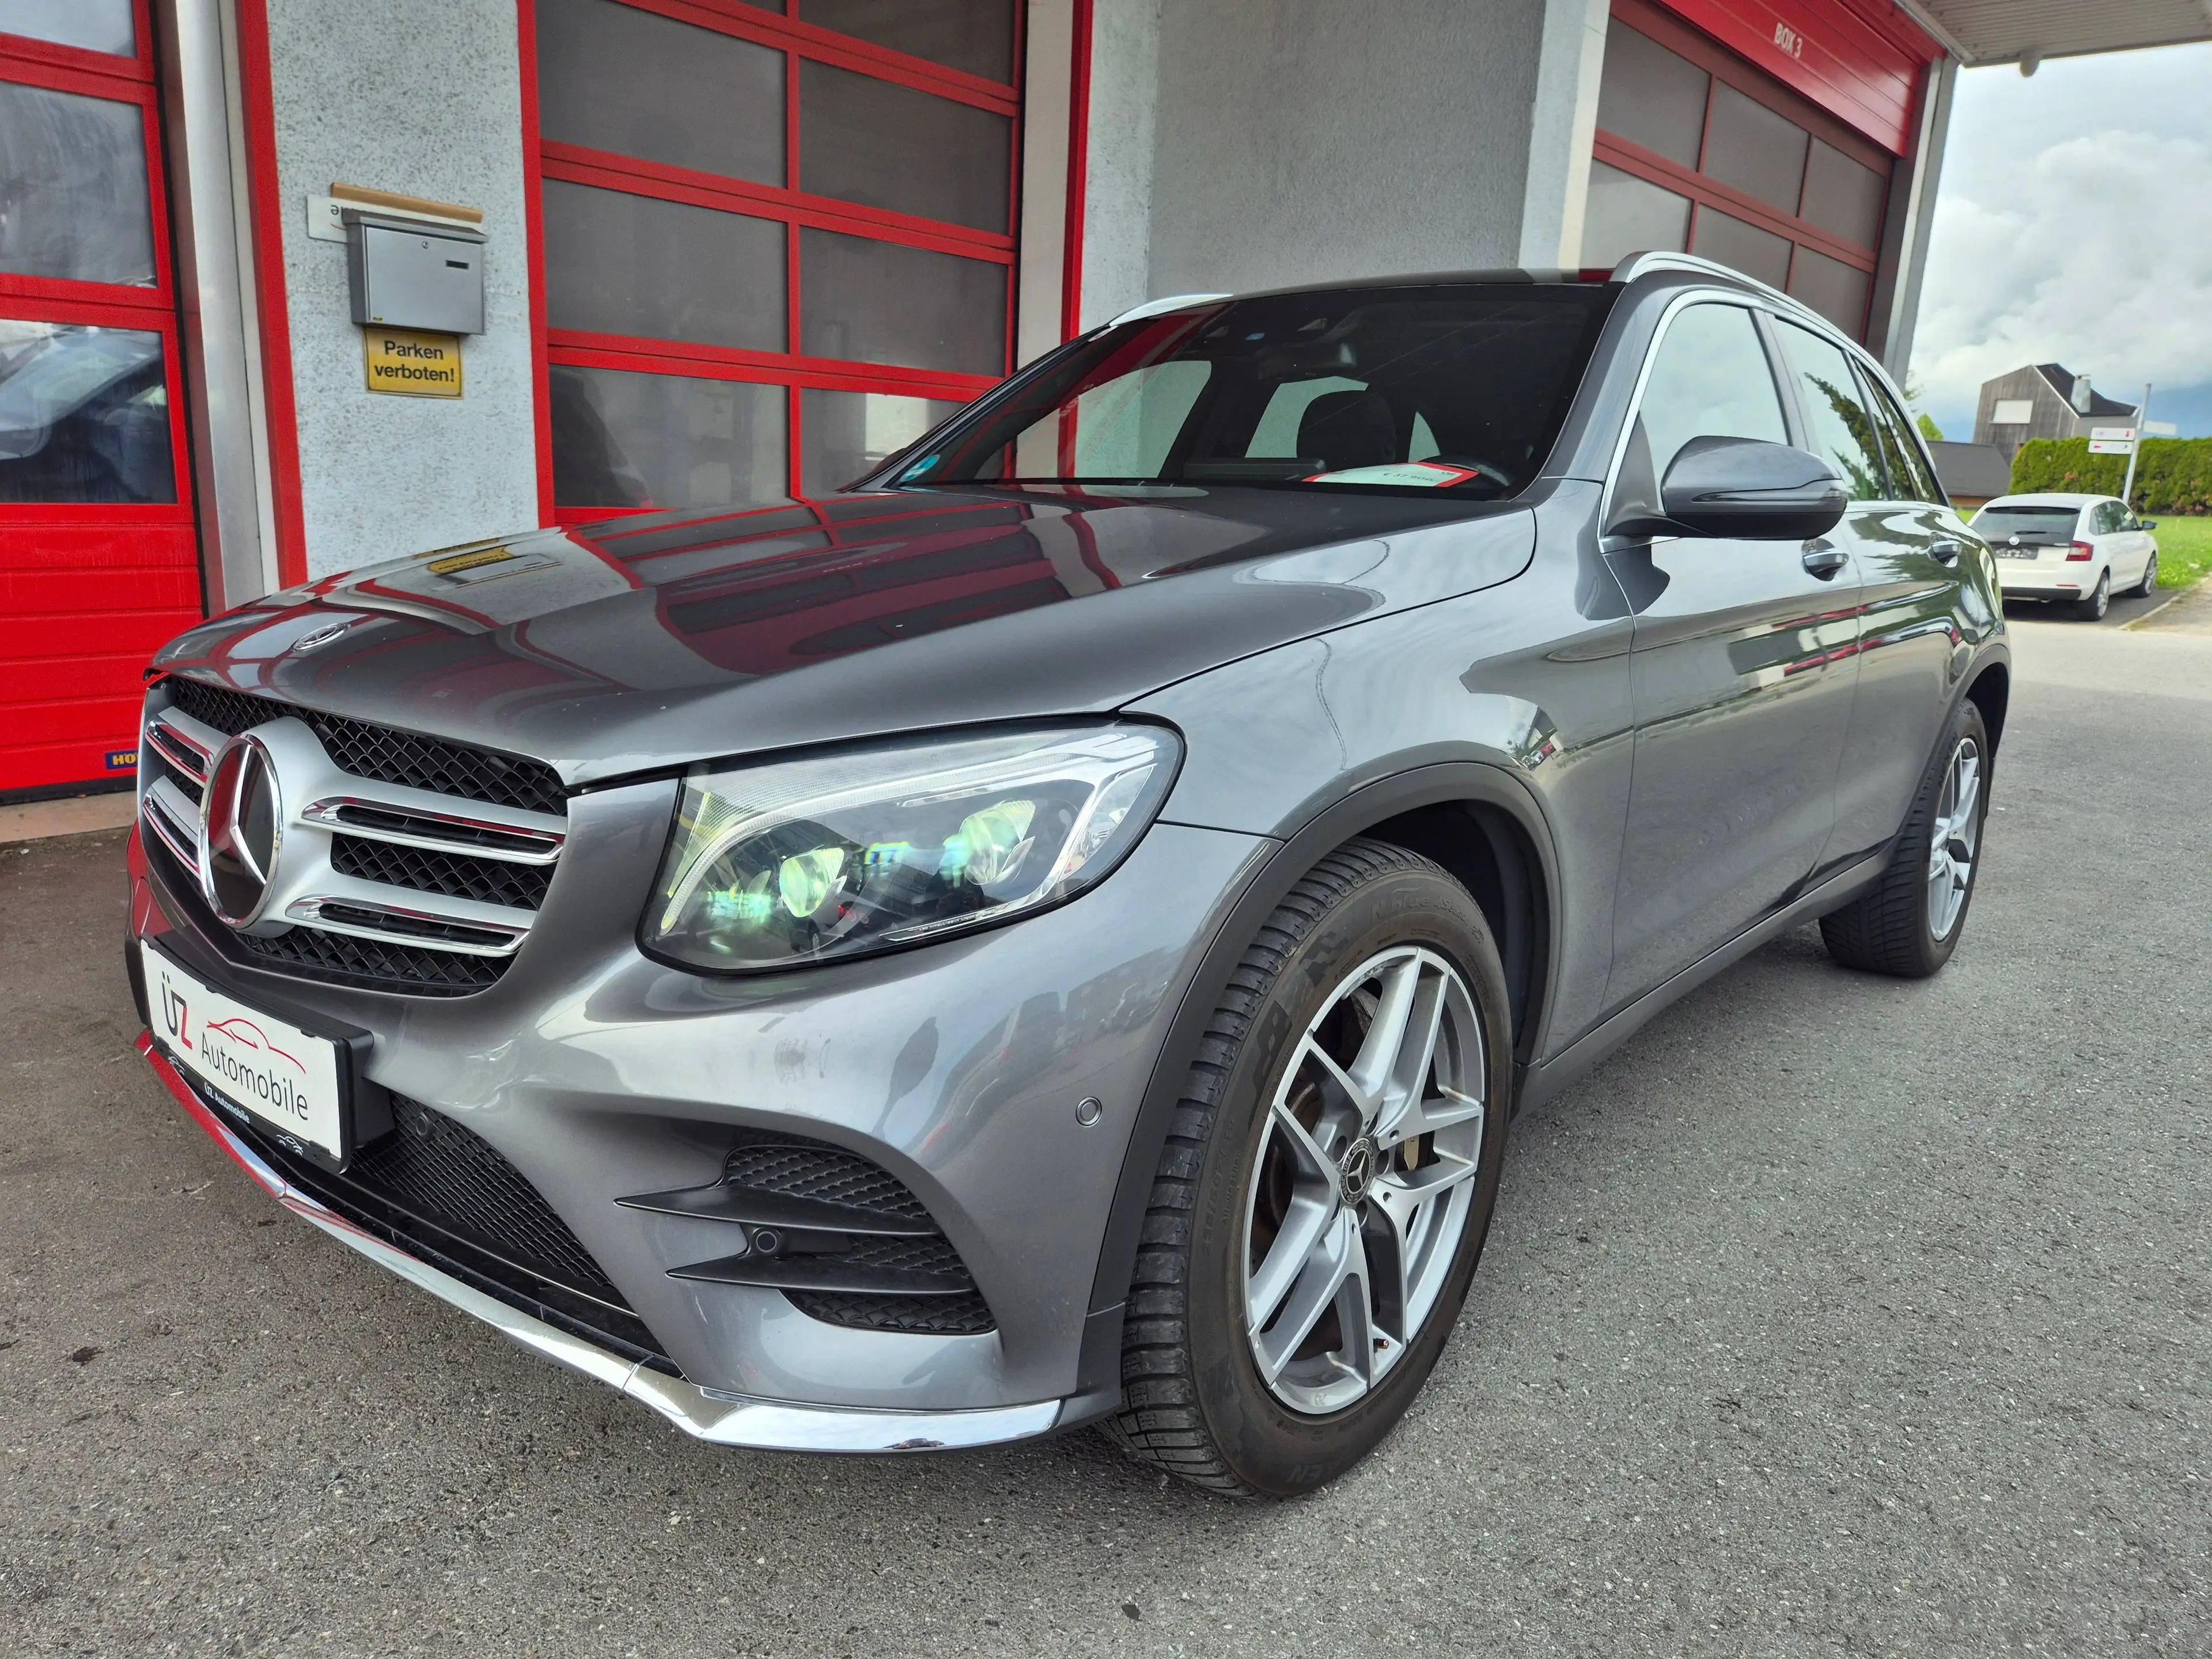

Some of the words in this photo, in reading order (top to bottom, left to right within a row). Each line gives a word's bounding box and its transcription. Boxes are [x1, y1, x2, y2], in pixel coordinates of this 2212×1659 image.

[1774, 22, 1796, 54] BOX
[1794, 37, 1803, 59] 3
[384, 340, 444, 360] Parken
[374, 364, 455, 382] verboten!
[161, 971, 193, 1050] ÜZ
[201, 1032, 308, 1120] Automobile
[215, 1092, 251, 1124] Automobile
